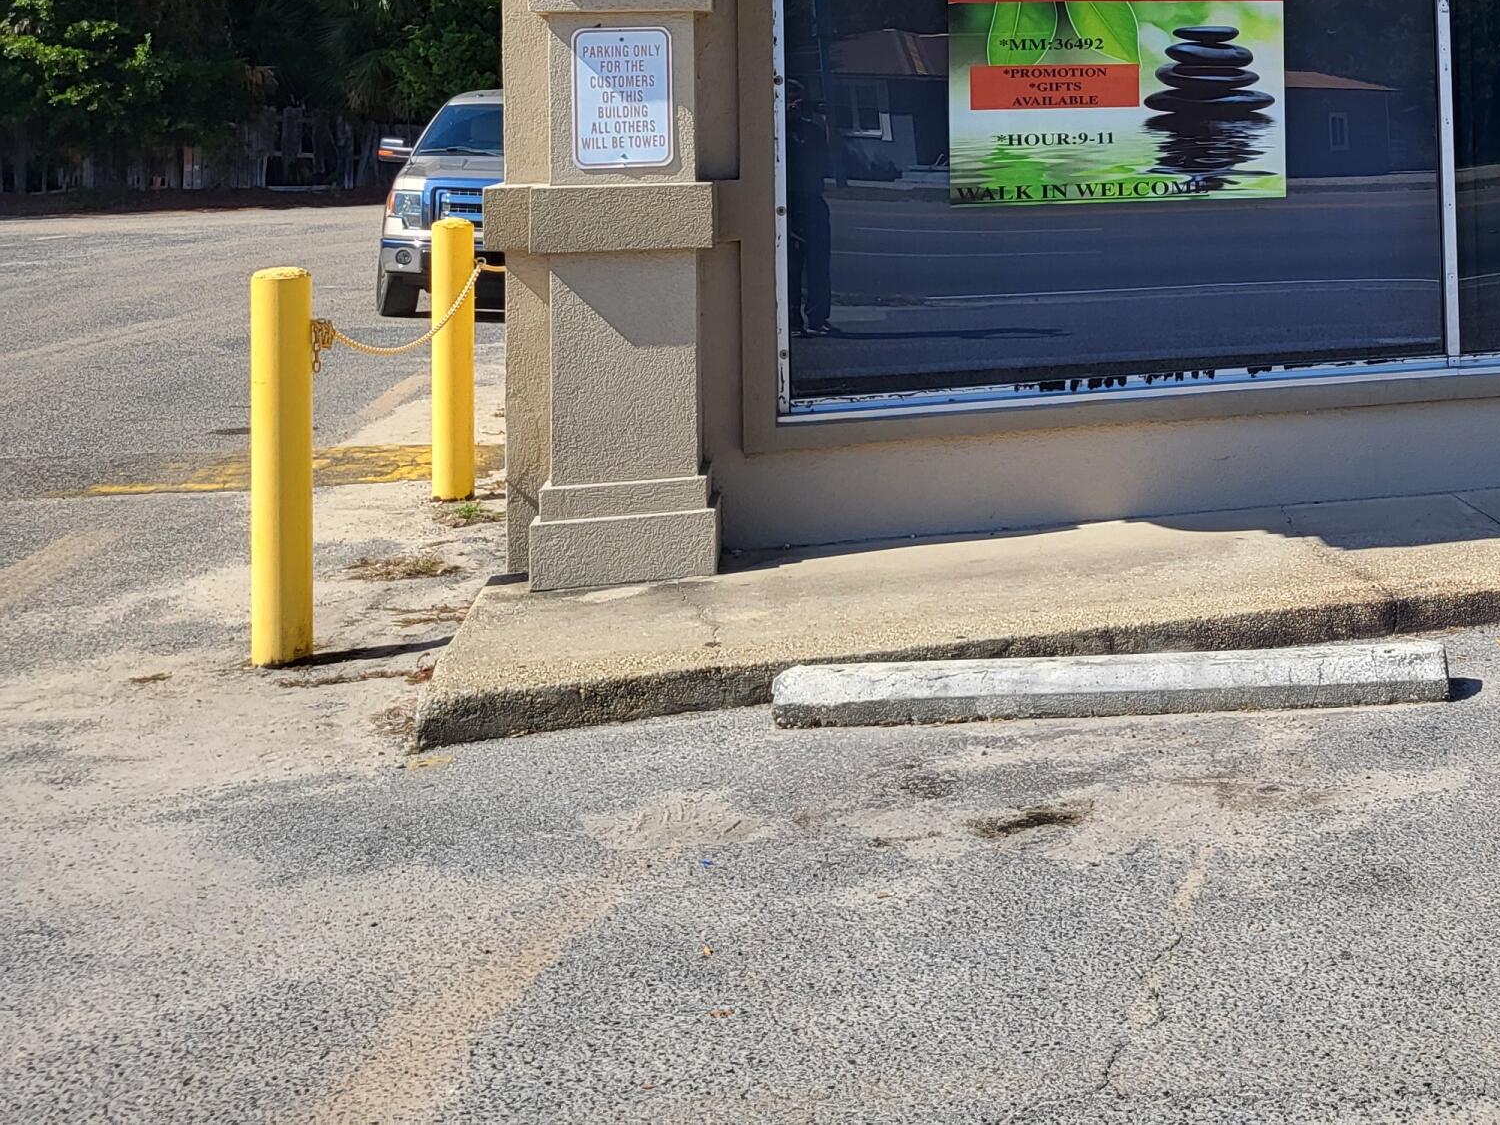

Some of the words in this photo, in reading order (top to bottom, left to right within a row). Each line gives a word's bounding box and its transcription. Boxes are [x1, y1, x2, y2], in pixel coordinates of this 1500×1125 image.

[582, 45, 629, 58] PARKING
[633, 44, 661, 57] ONLY
[600, 60, 620, 73] FOR
[625, 60, 645, 72] THE
[590, 75, 655, 88] CUSTOMERS
[602, 91, 615, 104] OF
[620, 90, 644, 103] THIS
[1012, 95, 1099, 106] AVAILABLE
[598, 106, 648, 119] BUILDING
[591, 122, 611, 134] ALL
[614, 120, 656, 133] OTHERS
[582, 137, 607, 150] WILL
[612, 136, 625, 149] BE
[629, 135, 665, 148] TOWED
[956, 184, 1034, 201] WALK
[1040, 183, 1067, 199] IN
[1071, 181, 1209, 198] WELCOME
